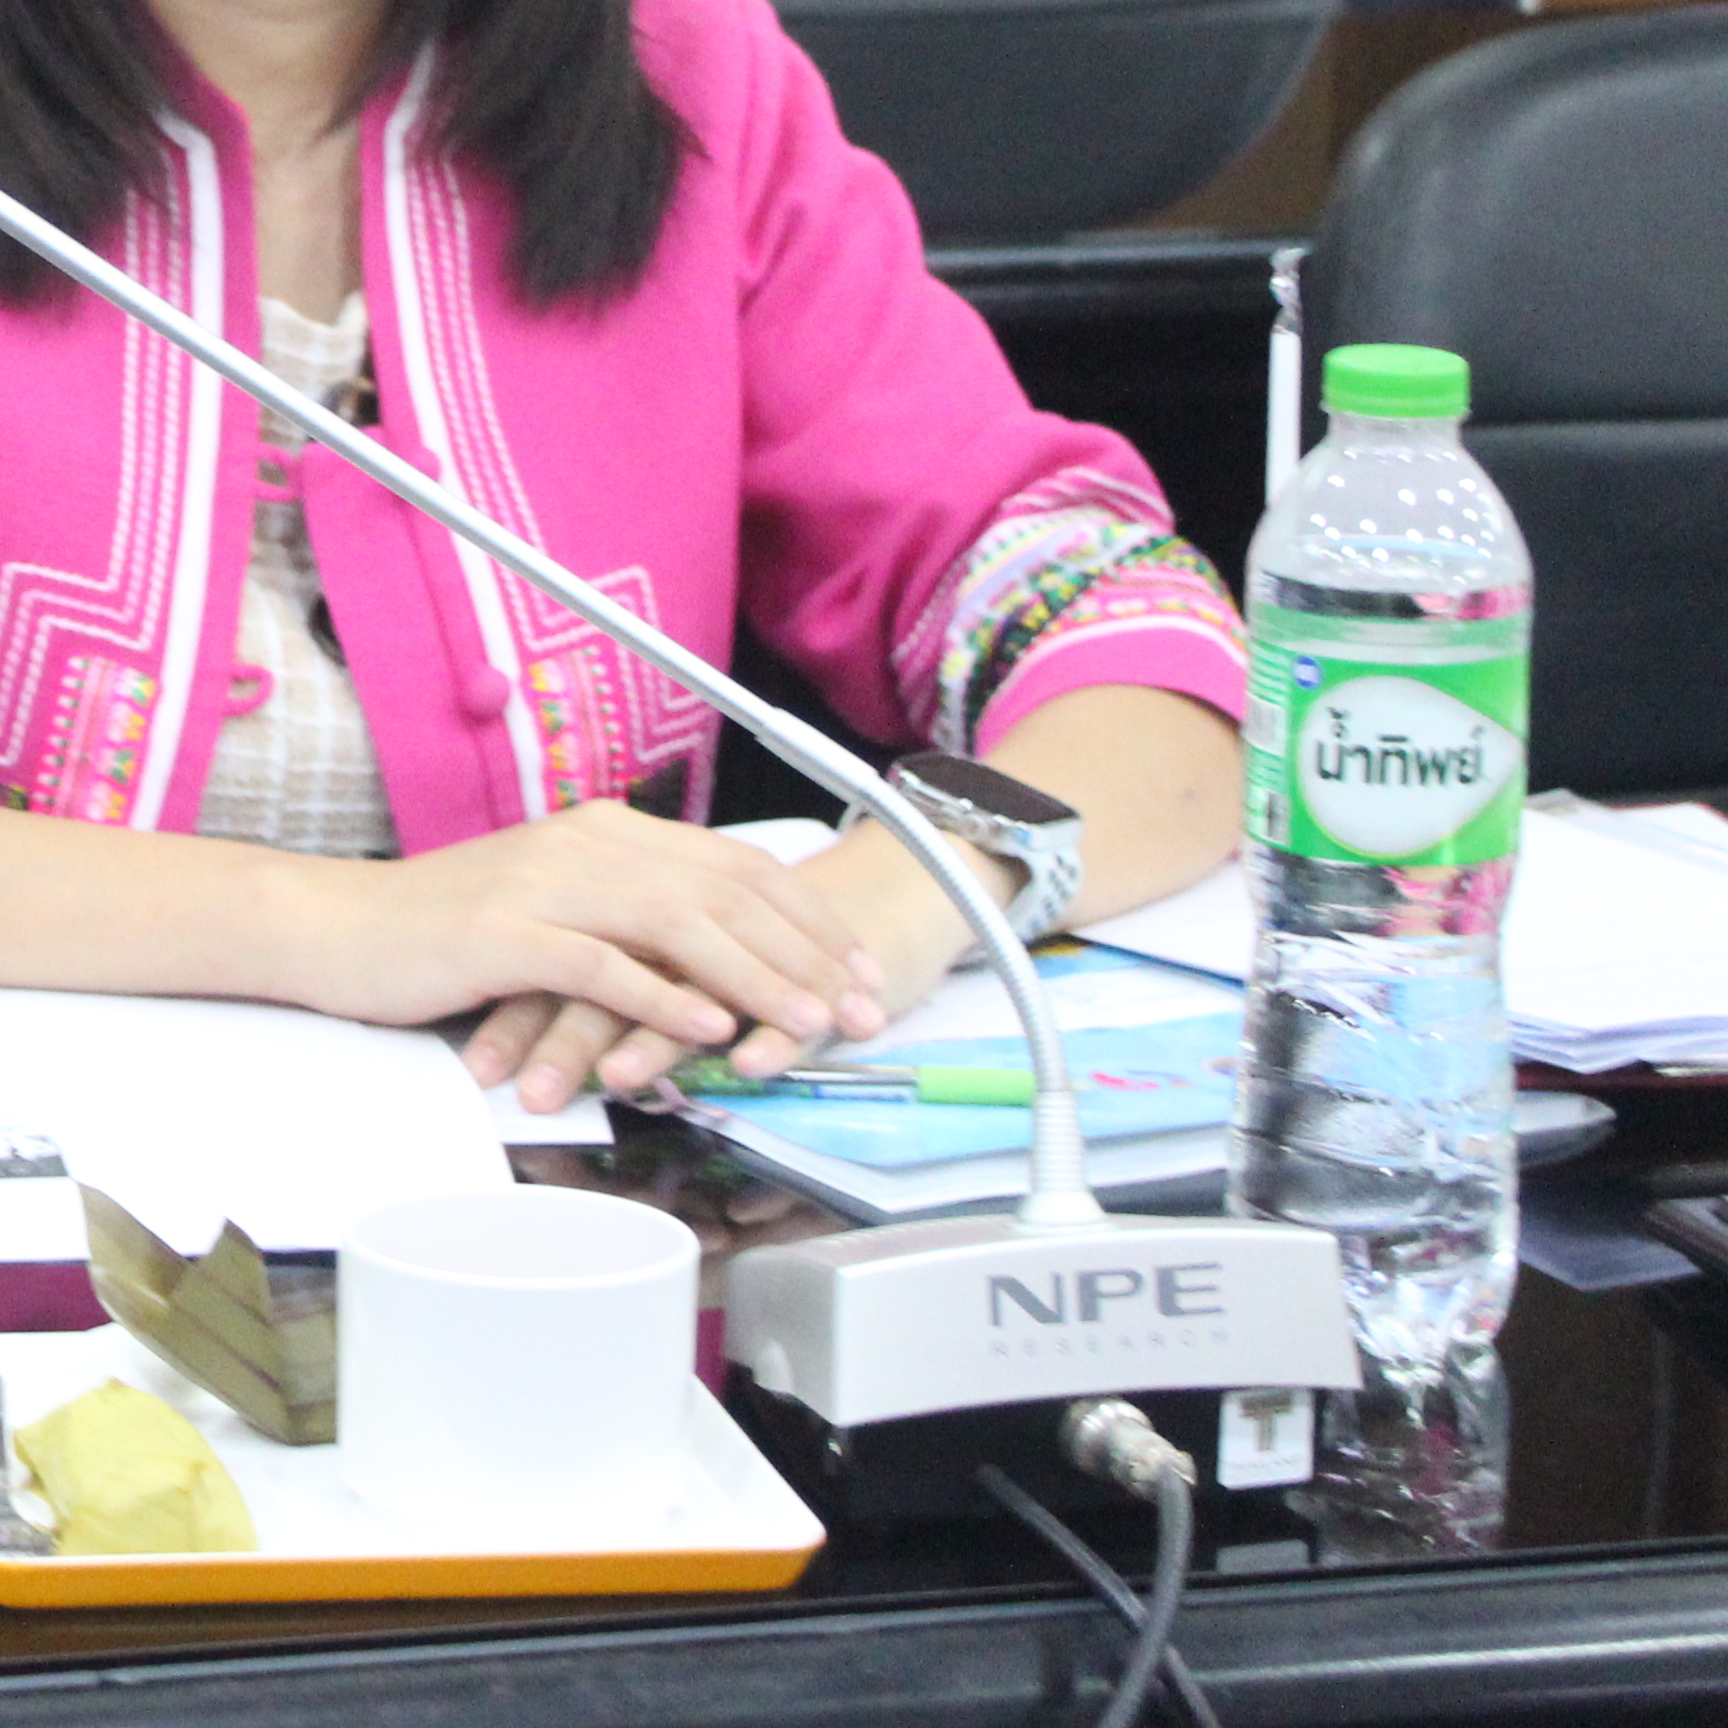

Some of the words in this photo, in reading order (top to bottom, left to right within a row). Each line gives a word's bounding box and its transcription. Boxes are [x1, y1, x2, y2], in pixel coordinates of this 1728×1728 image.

[1314, 705, 1485, 788] น้ำทิพย์
[988, 1262, 1227, 1328] NPE
